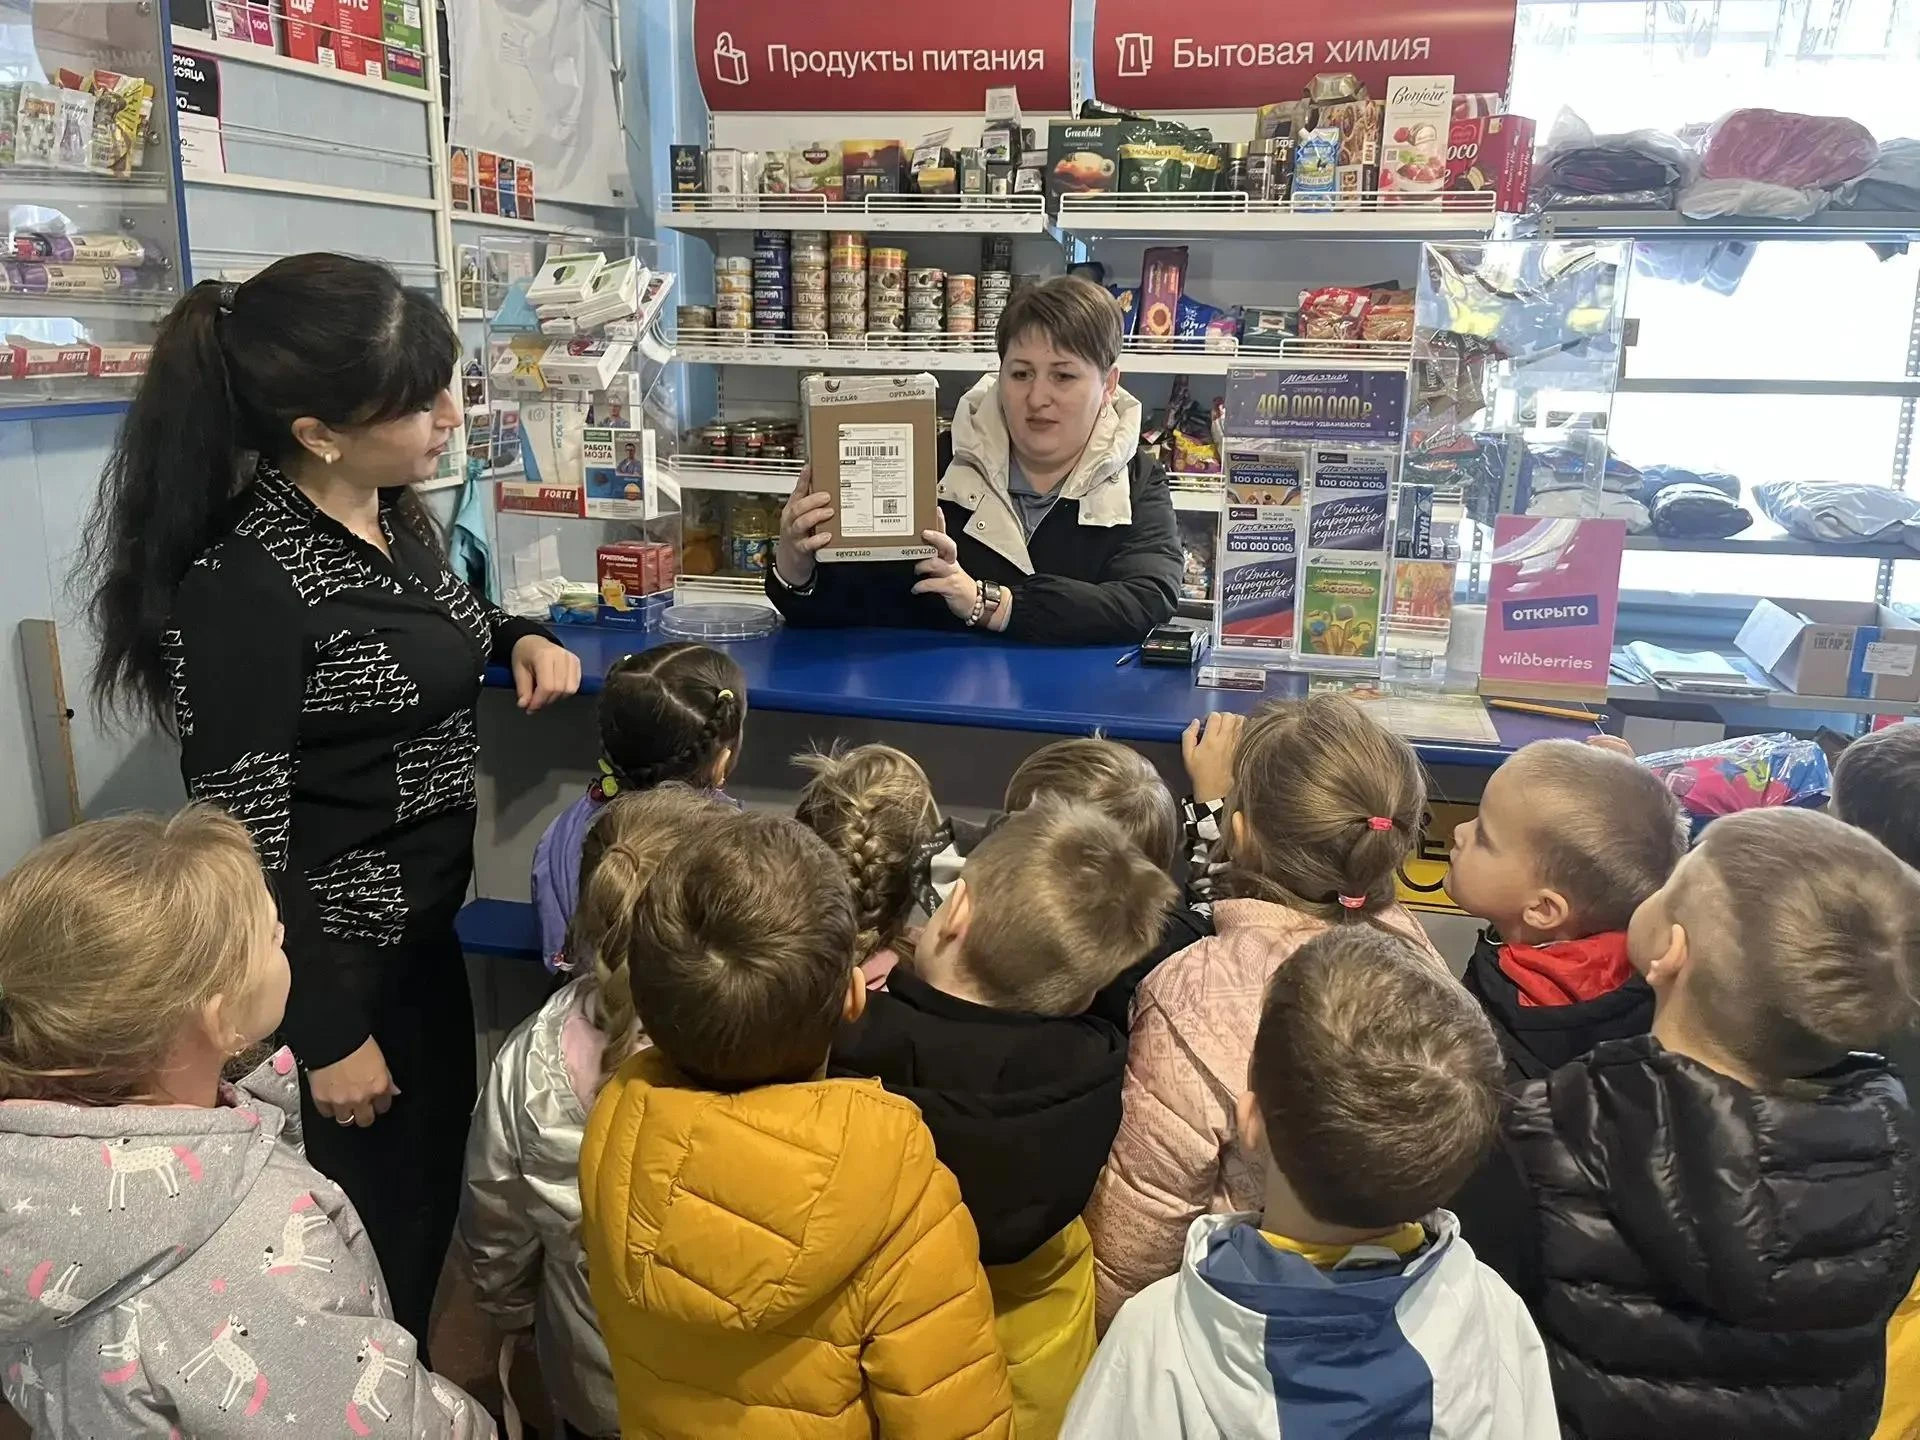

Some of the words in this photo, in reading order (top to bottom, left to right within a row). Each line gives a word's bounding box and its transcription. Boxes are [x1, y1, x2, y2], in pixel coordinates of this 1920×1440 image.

[252, 20, 268, 31] 100
[172, 54, 195, 67] РИФ
[767, 44, 914, 77] Продукты
[922, 47, 1044, 72] питания
[1173, 38, 1313, 69] Бытовая
[1324, 37, 1430, 64] химия
[173, 65, 205, 82] ЕСЯЦА
[1392, 85, 1448, 107] Bonjour
[1065, 127, 1102, 138] Greenfield
[1447, 143, 1478, 161] oco
[62, 352, 85, 361] FORTE
[821, 394, 858, 403] ОРГАЛАЙФ
[889, 389, 926, 398] ОРГАЛАЙФ
[1257, 394, 1289, 418] 400
[1292, 394, 1323, 418] 000
[584, 444, 612, 452] РАБОТА
[1234, 475, 1251, 483] 100
[1253, 476, 1273, 484] 000
[1319, 479, 1337, 487] 100
[1339, 480, 1360, 488] 000
[544, 489, 572, 499] FORTE
[1334, 502, 1375, 516] Днём
[1312, 513, 1383, 530] народного
[1313, 519, 1385, 546] единства!
[1417, 516, 1430, 556] HALLS
[1230, 541, 1248, 550] 100
[1250, 542, 1270, 551] 000
[1245, 567, 1285, 580] Днём
[1225, 577, 1293, 594] народного
[1227, 584, 1295, 609] единства!
[1512, 605, 1589, 621] ОТКРЫТО
[1499, 652, 1593, 670] wildberries
